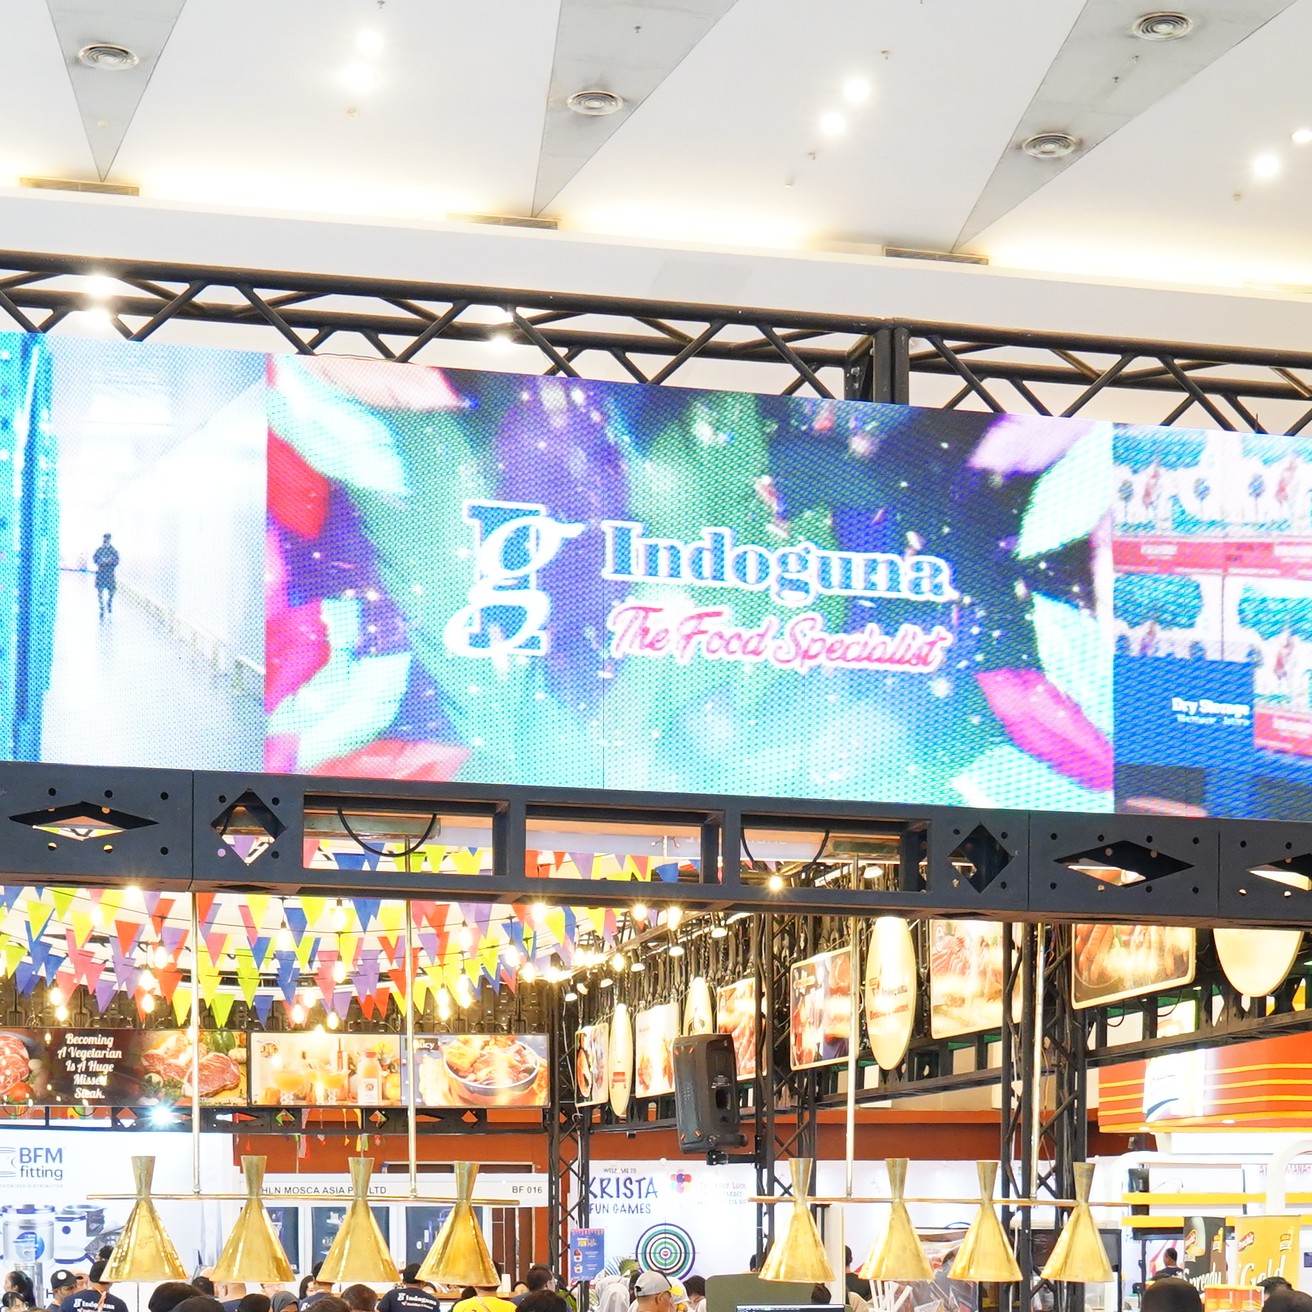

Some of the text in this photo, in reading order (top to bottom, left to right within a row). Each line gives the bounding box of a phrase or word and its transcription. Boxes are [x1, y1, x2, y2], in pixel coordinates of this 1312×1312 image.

[601, 519, 959, 606] Indoguna
[609, 603, 953, 672] The Food Specialist
[65, 1033, 114, 1048] Becoming
[57, 1046, 122, 1061] A Vegetarian
[65, 1060, 115, 1075] Is A Huge
[19, 1147, 63, 1164] BFM
[20, 1165, 63, 1181] fitting
[284, 1186, 321, 1195] MOSCA
[322, 1186, 346, 1195] ASIA
[369, 1186, 387, 1195] LTD
[512, 1185, 543, 1194] BF 016
[589, 1176, 659, 1199] KRISTA
[589, 1203, 651, 1214] FUN GAMES
